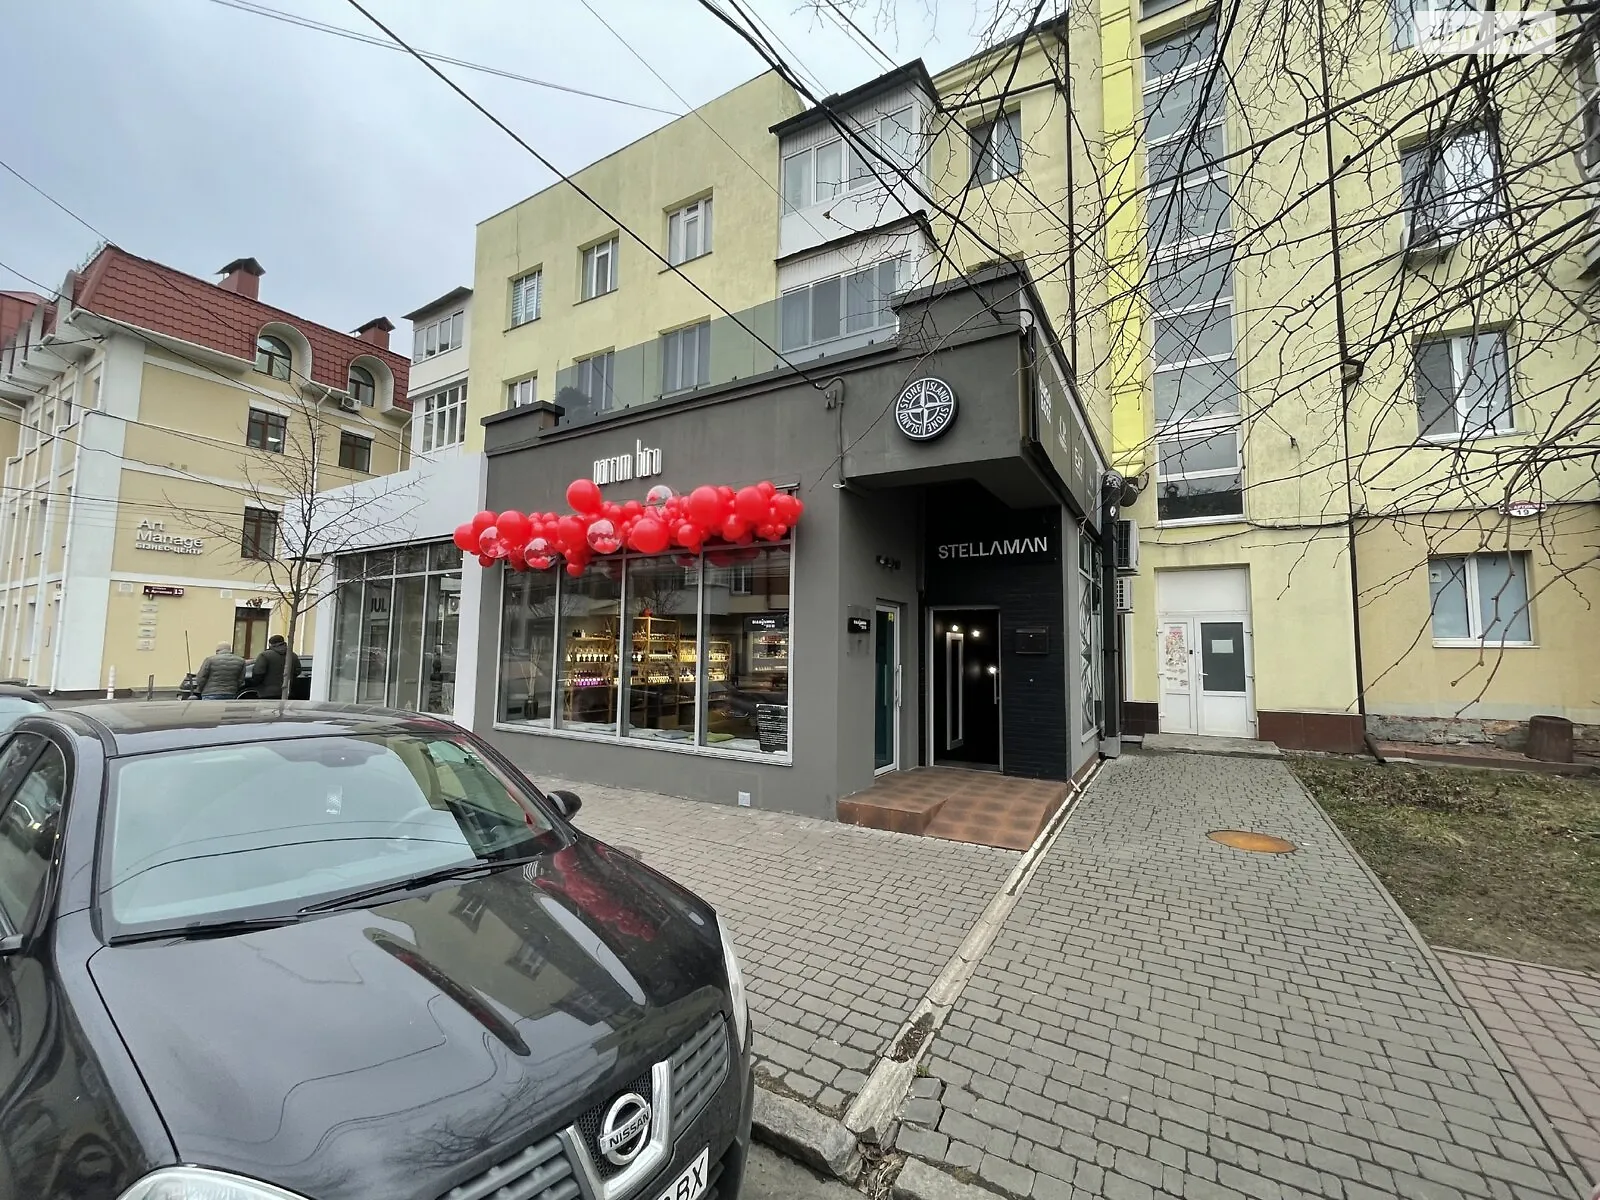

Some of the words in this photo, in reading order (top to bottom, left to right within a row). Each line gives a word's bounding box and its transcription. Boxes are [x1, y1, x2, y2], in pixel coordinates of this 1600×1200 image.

[900, 383, 922, 409] STONE
[926, 381, 950, 403] ISLAND
[900, 413, 922, 434] ISLAND
[926, 407, 949, 432] STONE
[135, 542, 204, 555] БІЗНЕС-ЦЕНТР
[136, 529, 204, 549] Manage
[609, 1111, 650, 1148] NISSAN
